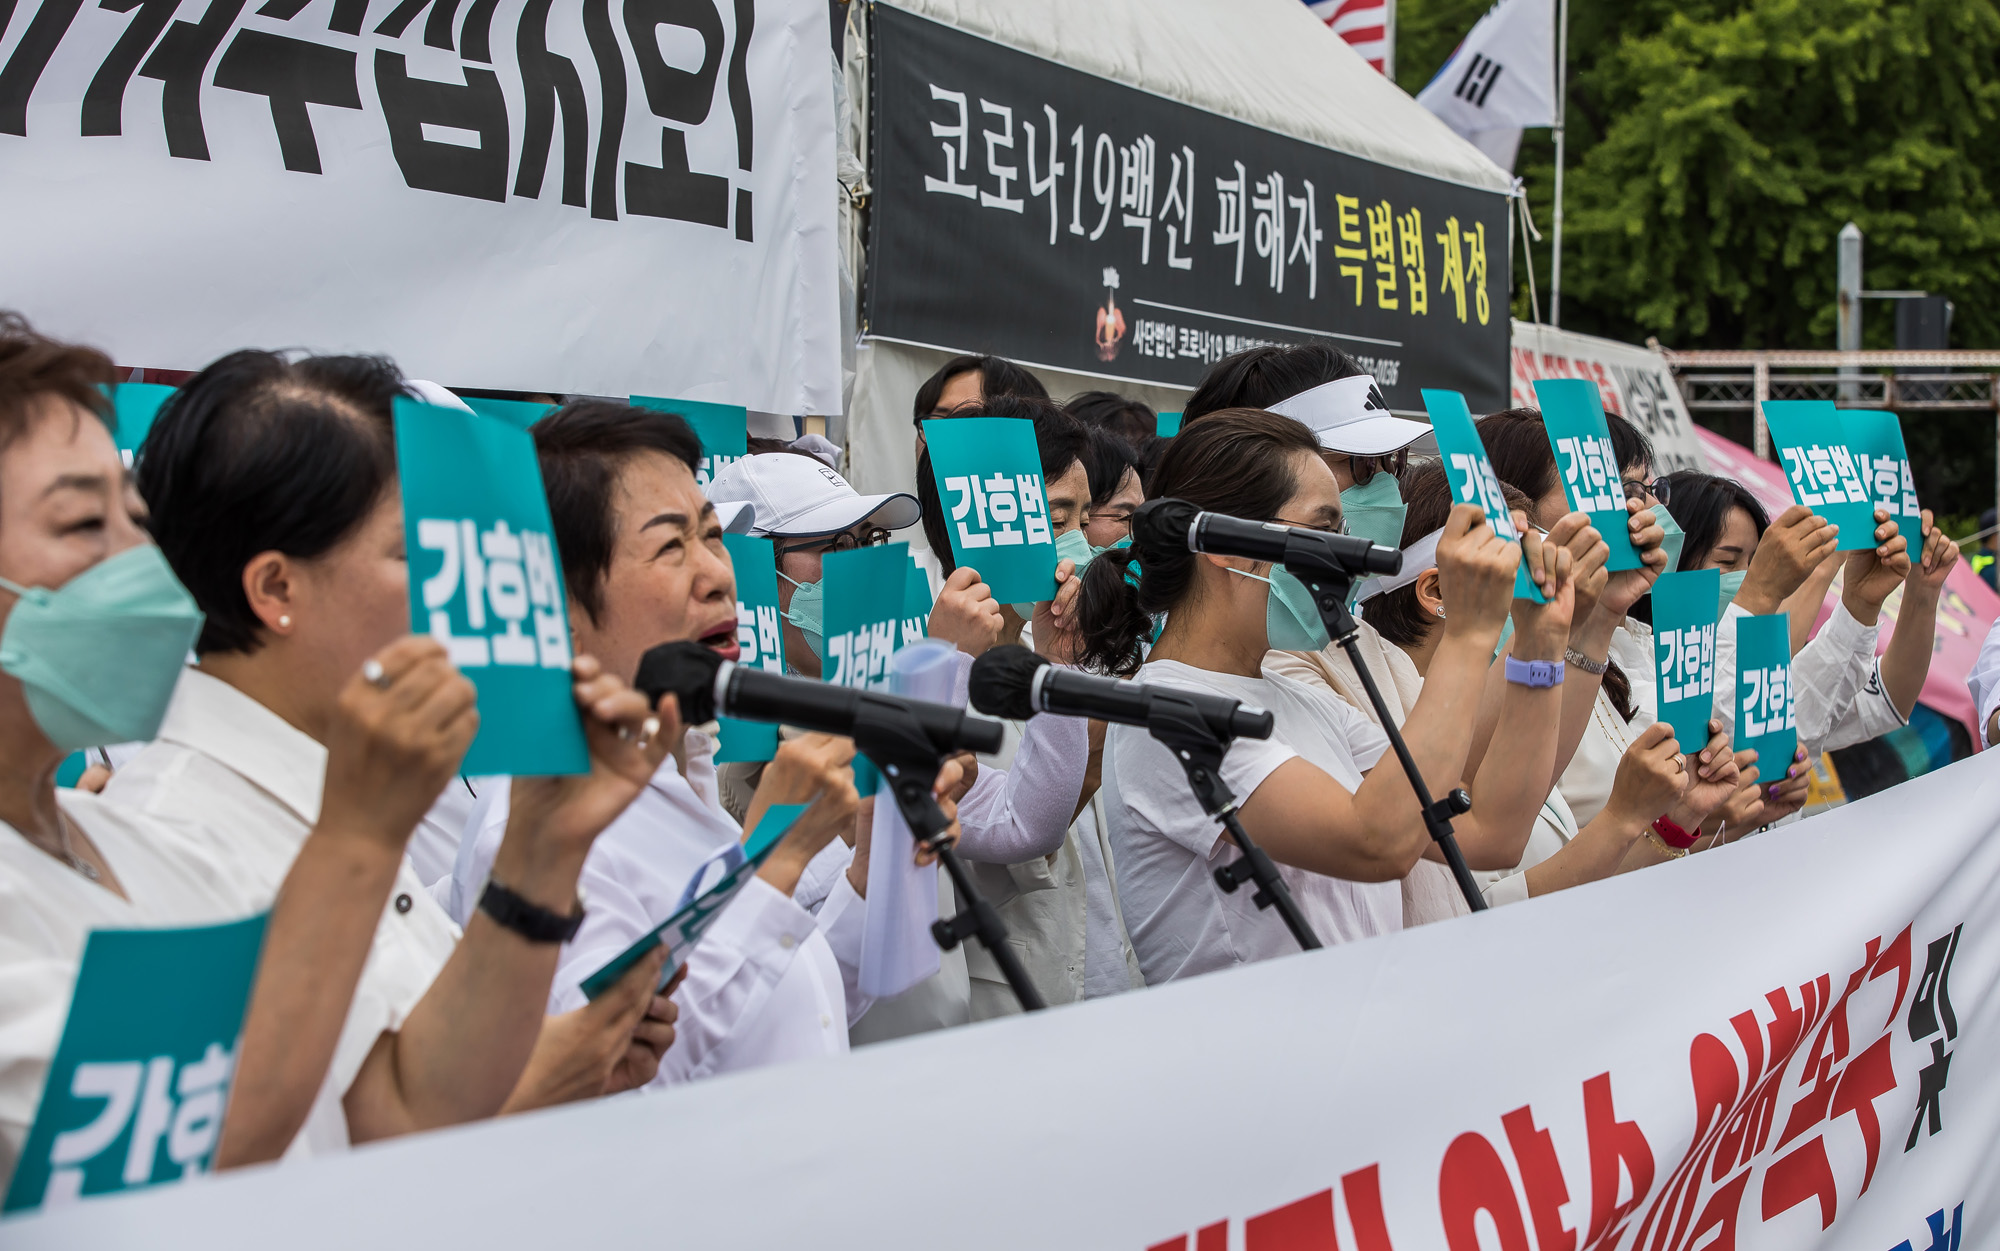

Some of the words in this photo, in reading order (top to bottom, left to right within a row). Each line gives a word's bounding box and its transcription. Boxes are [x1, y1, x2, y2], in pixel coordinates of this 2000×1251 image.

[924, 83, 1195, 271] 코로나19백신
[1212, 159, 1323, 300] 피해자
[1334, 192, 1428, 316] 특별법
[1436, 215, 1491, 326] 제정
[1133, 319, 1176, 359] 사단법인
[1178, 328, 1223, 365] 코로나19
[944, 471, 1053, 549] 간호법
[1557, 435, 1628, 513] 간호법
[1782, 444, 1868, 507] 간호법
[417, 518, 573, 669] 간호법
[1659, 622, 1715, 704] 간호법
[1903, 922, 1964, 1154] 및
